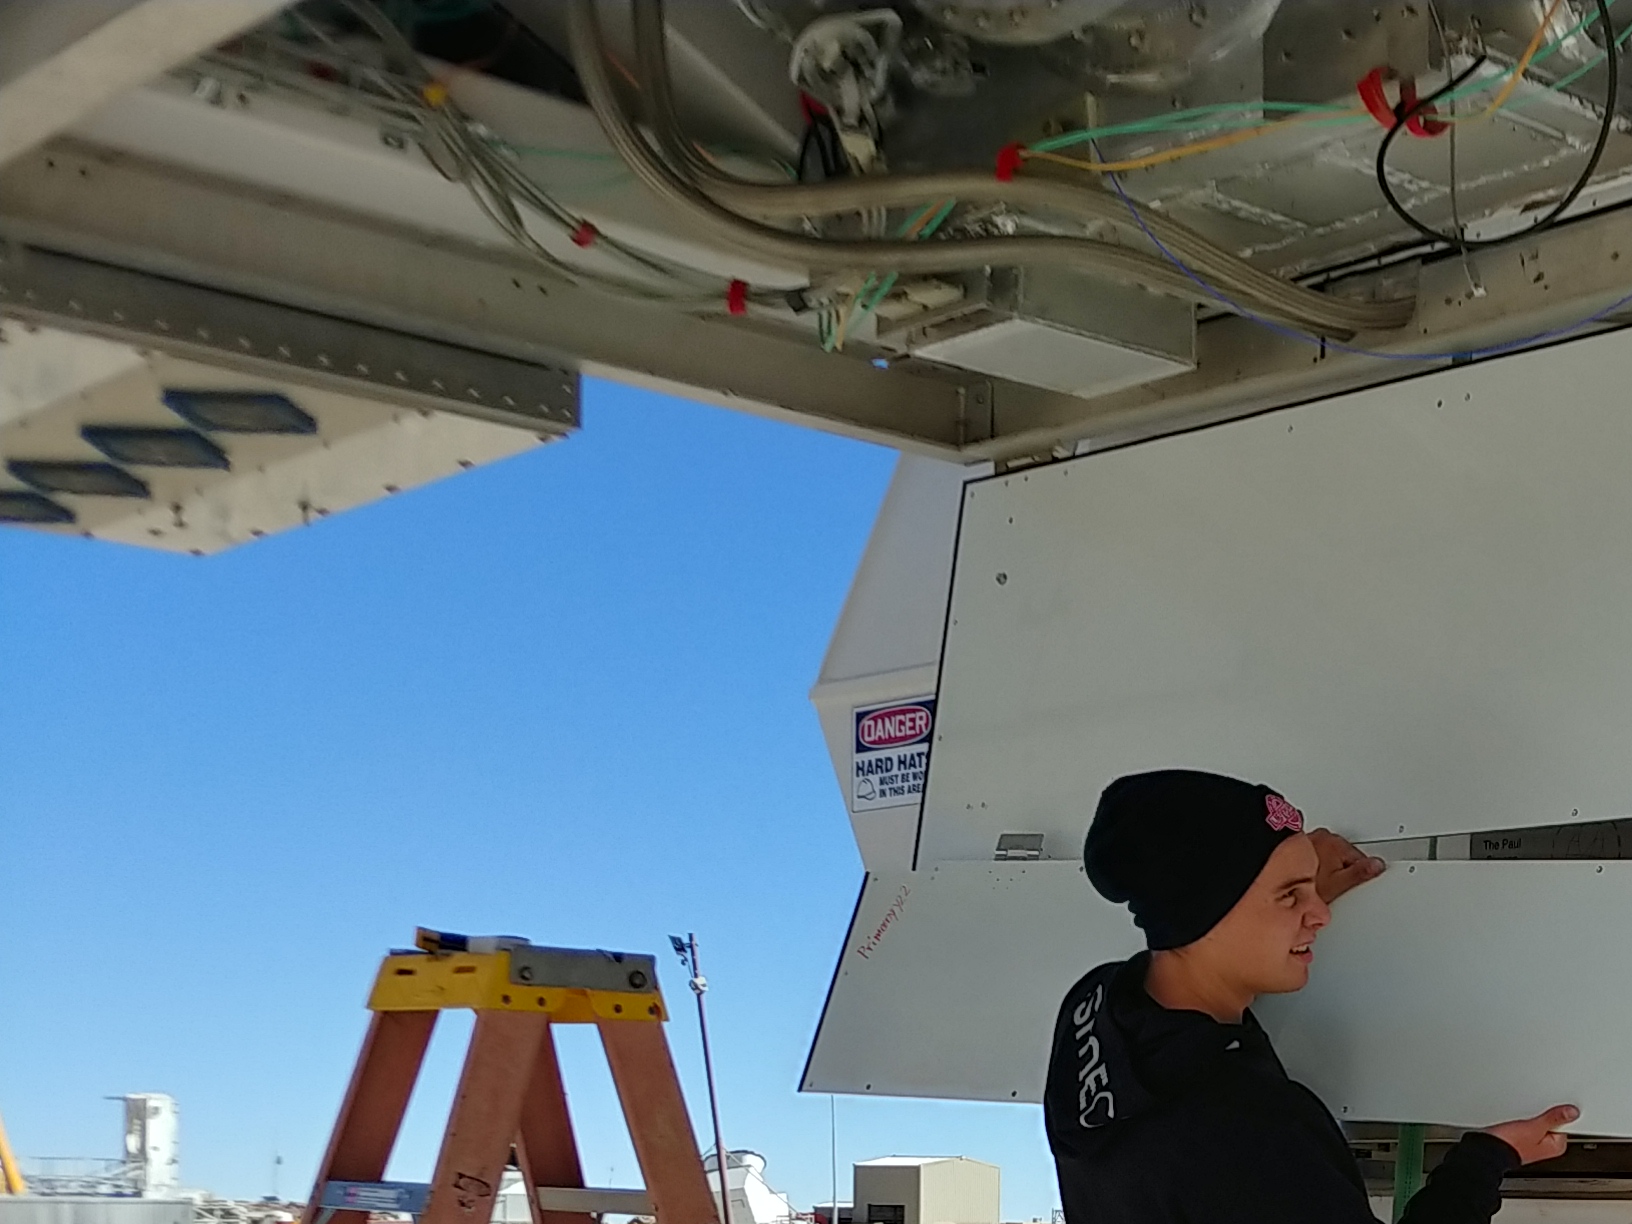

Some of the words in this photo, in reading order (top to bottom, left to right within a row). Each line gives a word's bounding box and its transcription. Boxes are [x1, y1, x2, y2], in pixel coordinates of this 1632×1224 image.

[863, 711, 928, 743] DANGER
[856, 756, 894, 778] HARD
[879, 774, 899, 787] MUST
[900, 771, 910, 784] BE
[879, 788, 886, 799] IN
[888, 785, 905, 797] THIS
[1483, 839, 1500, 851] The
[1502, 837, 1522, 850] Paul
